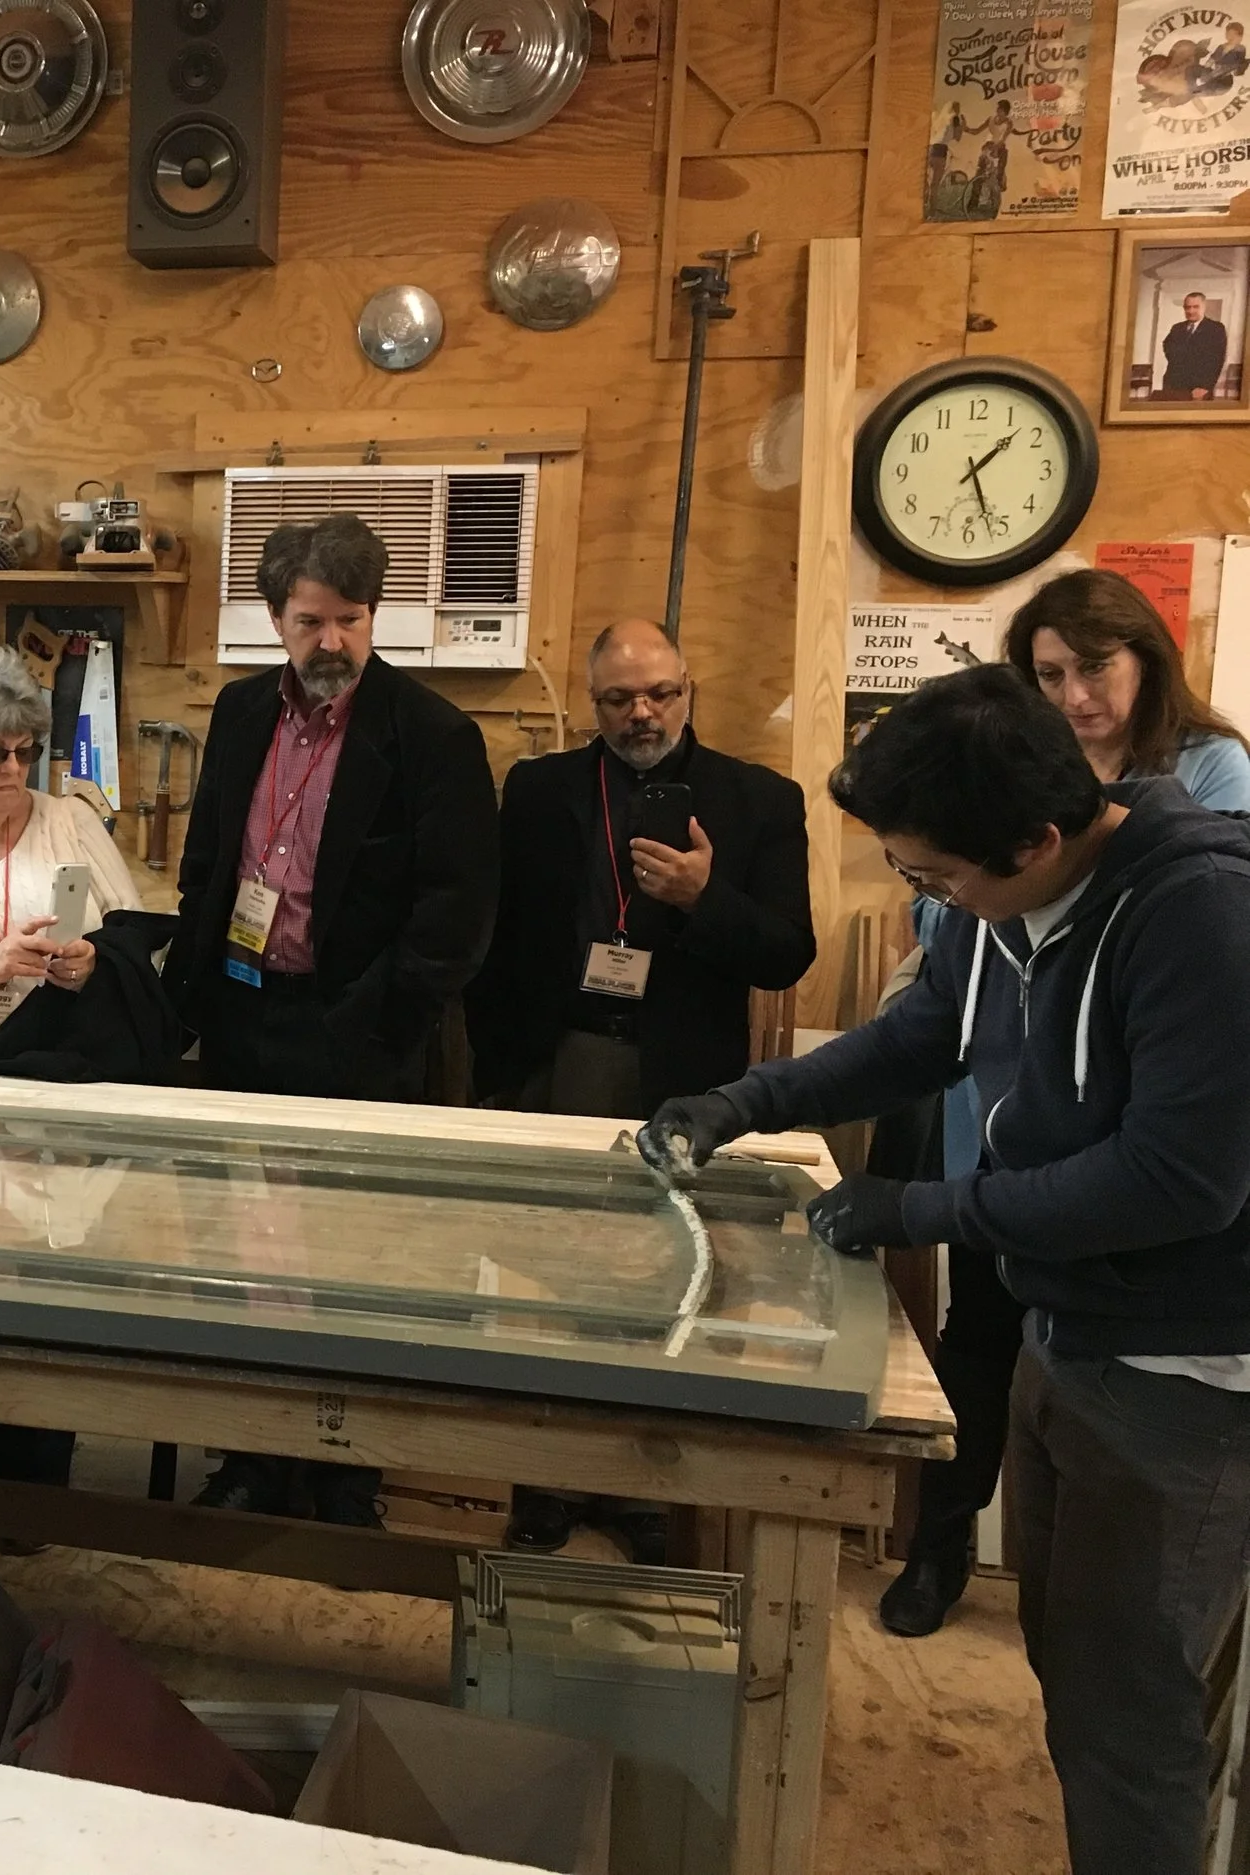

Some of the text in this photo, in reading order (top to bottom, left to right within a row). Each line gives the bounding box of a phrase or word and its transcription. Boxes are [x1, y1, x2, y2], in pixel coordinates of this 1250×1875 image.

[952, 11, 975, 21] Days
[989, 10, 1014, 20] Week
[948, 28, 1012, 57] Summer
[1137, 16, 1176, 57] HOT
[944, 44, 1087, 86] Spider House
[983, 64, 1080, 100] Ballroom
[1027, 122, 1081, 153] Party
[1112, 156, 1180, 178] WHITE
[1137, 174, 1166, 187] APRIL
[1201, 166, 1212, 177] 21
[1218, 164, 1230, 175] 28
[1173, 181, 1207, 191] 8:00PM
[1216, 179, 1248, 189] 9:30PM
[937, 409, 951, 430] 11
[968, 398, 989, 421] 12
[1007, 406, 1014, 427] 1
[911, 432, 929, 453] 10
[1029, 427, 1043, 448] 2
[896, 463, 908, 485] 9
[1039, 459, 1052, 481] 3
[904, 494, 917, 515] 8
[1022, 493, 1035, 514] 4
[929, 516, 941, 537] 7
[962, 524, 975, 544] 6
[996, 515, 1010, 537] 5
[852, 615, 907, 628] WHEN
[76, 630, 99, 638] THE
[865, 635, 913, 648] RAIN
[855, 655, 918, 668] STOPS
[607, 949, 635, 961] Murray
